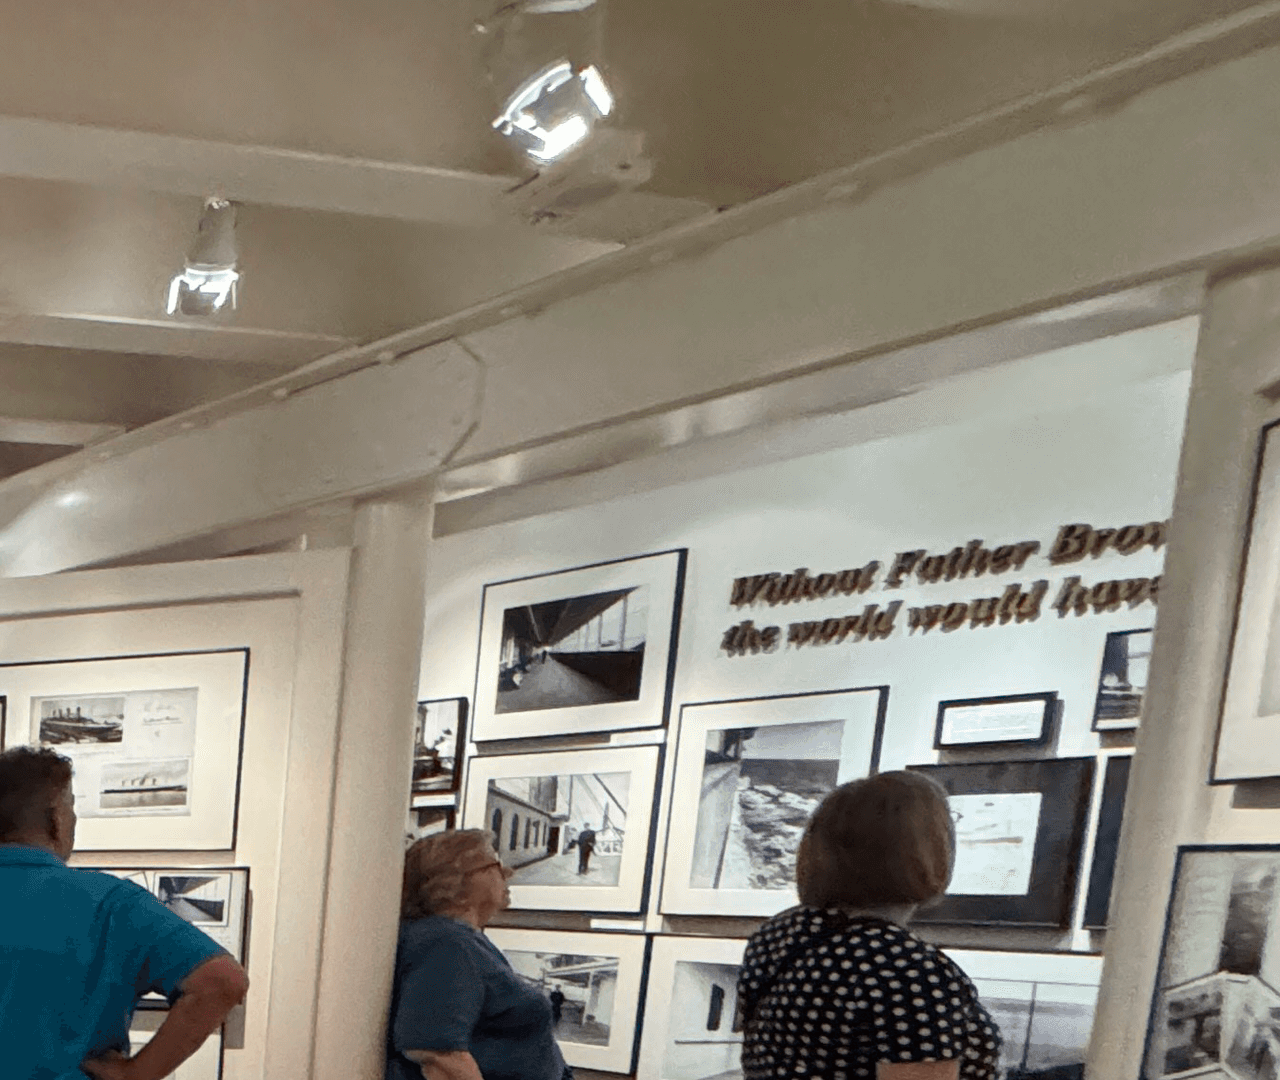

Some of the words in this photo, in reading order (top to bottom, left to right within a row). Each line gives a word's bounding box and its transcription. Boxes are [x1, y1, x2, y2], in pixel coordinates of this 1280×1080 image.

[730, 561, 881, 607] Without
[883, 539, 1041, 590] Father
[720, 620, 781, 658] the
[787, 600, 905, 650] world
[906, 579, 1049, 635] would
